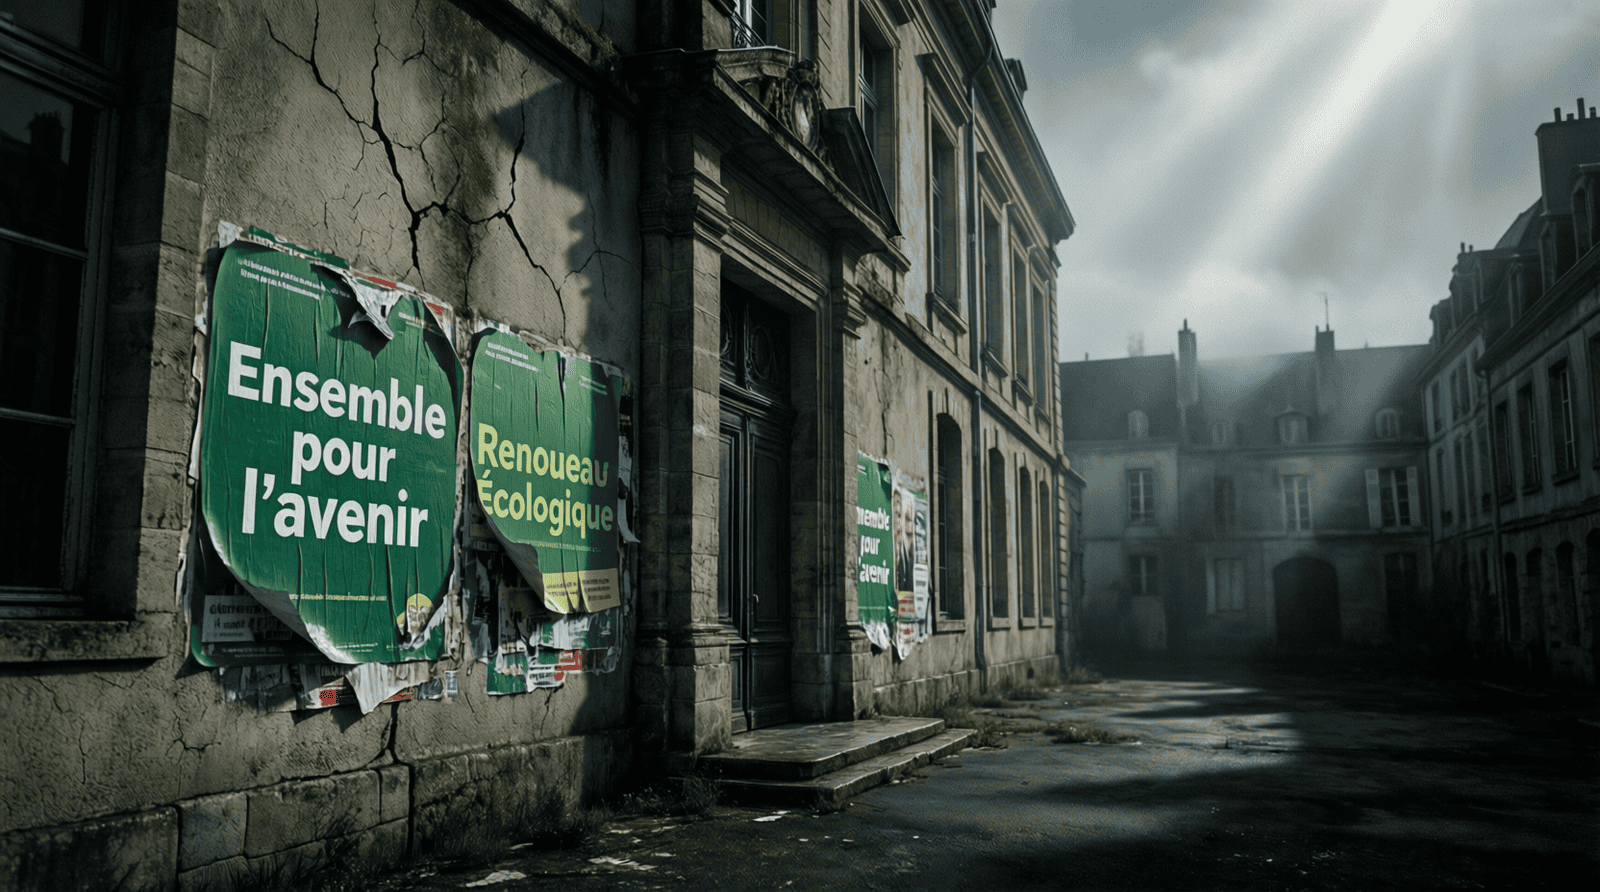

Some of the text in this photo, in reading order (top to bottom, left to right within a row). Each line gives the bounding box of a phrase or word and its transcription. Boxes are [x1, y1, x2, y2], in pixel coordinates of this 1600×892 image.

[227, 341, 447, 439] Ensemble
[291, 430, 396, 485] pour
[478, 422, 609, 487] Renoueau
[242, 467, 429, 548] l’avenir
[476, 469, 614, 539] Écologique
